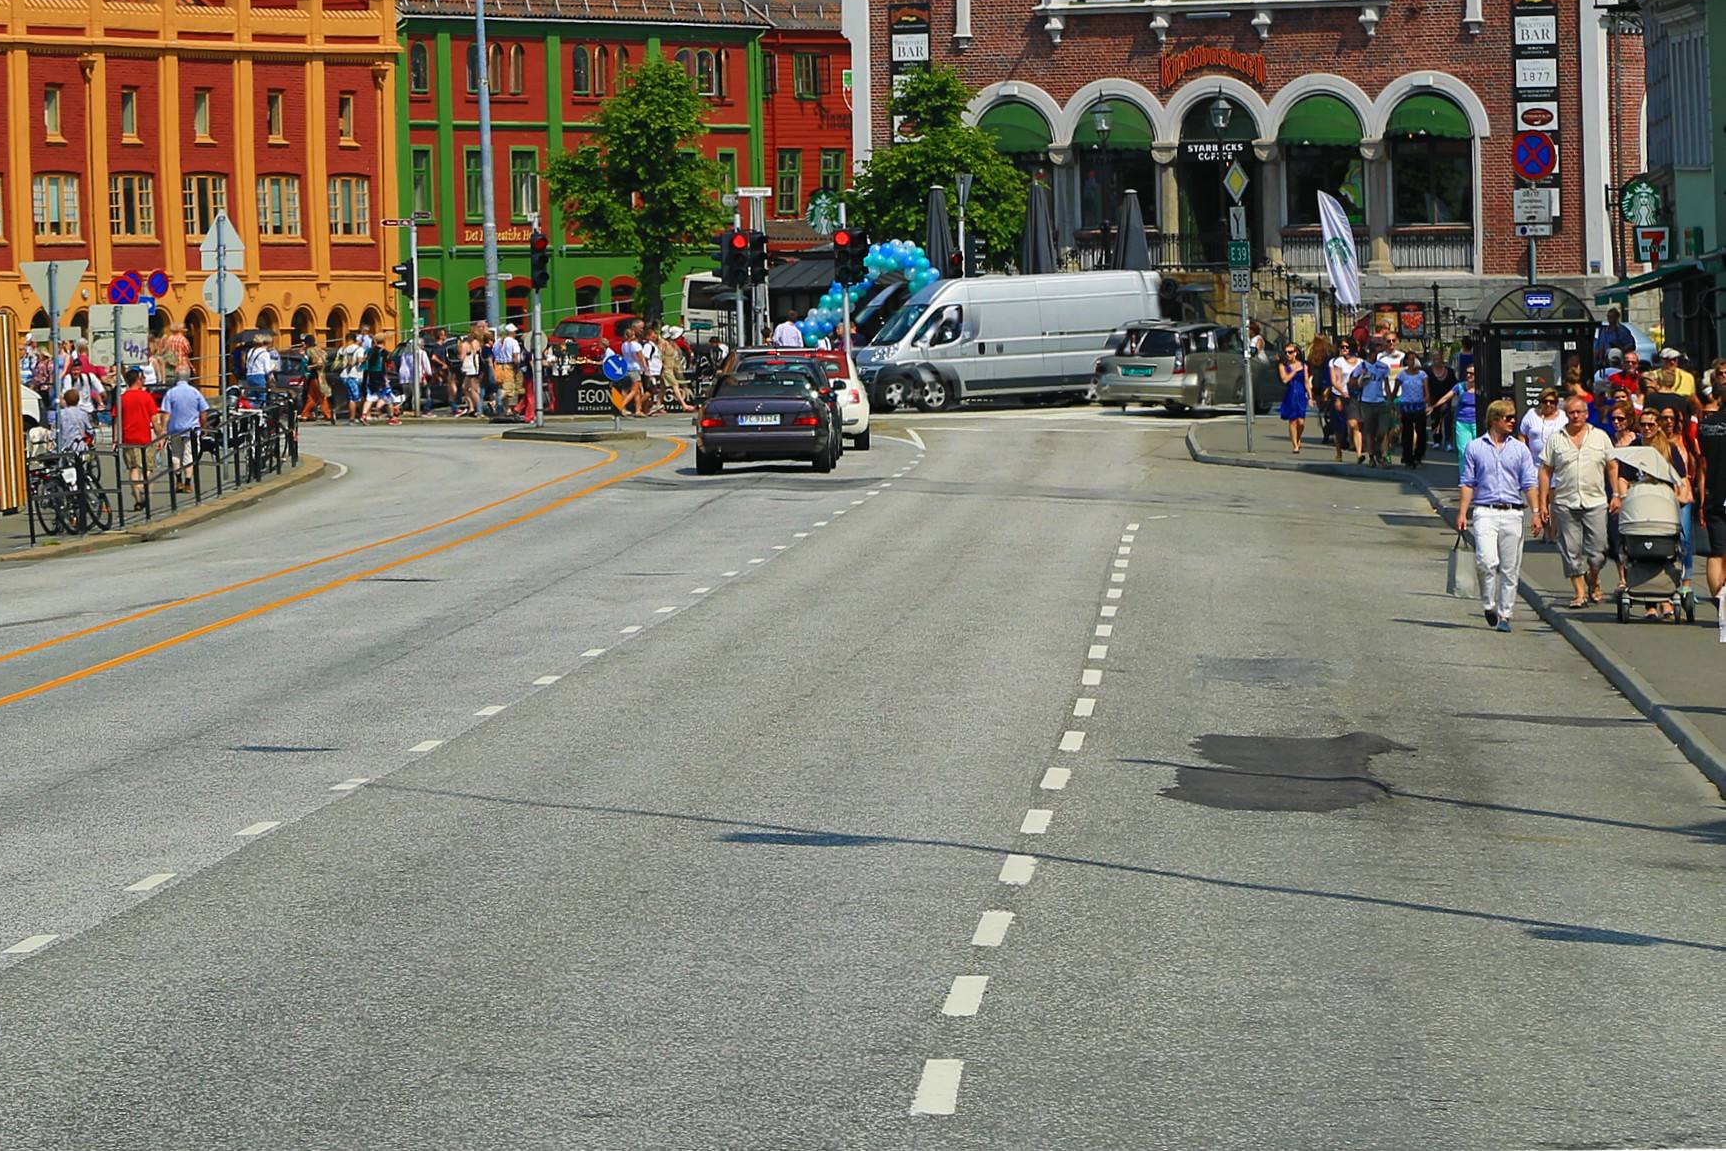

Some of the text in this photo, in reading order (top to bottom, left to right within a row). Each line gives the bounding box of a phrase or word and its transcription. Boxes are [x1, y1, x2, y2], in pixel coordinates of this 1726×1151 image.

[1521, 28, 1550, 40] BAR
[897, 46, 925, 57] BAR
[1522, 72, 1550, 81] 1877
[465, 230, 479, 241] Det
[1641, 231, 1665, 262] 7
[1233, 273, 1248, 288] 585
[577, 389, 613, 404] EGON
